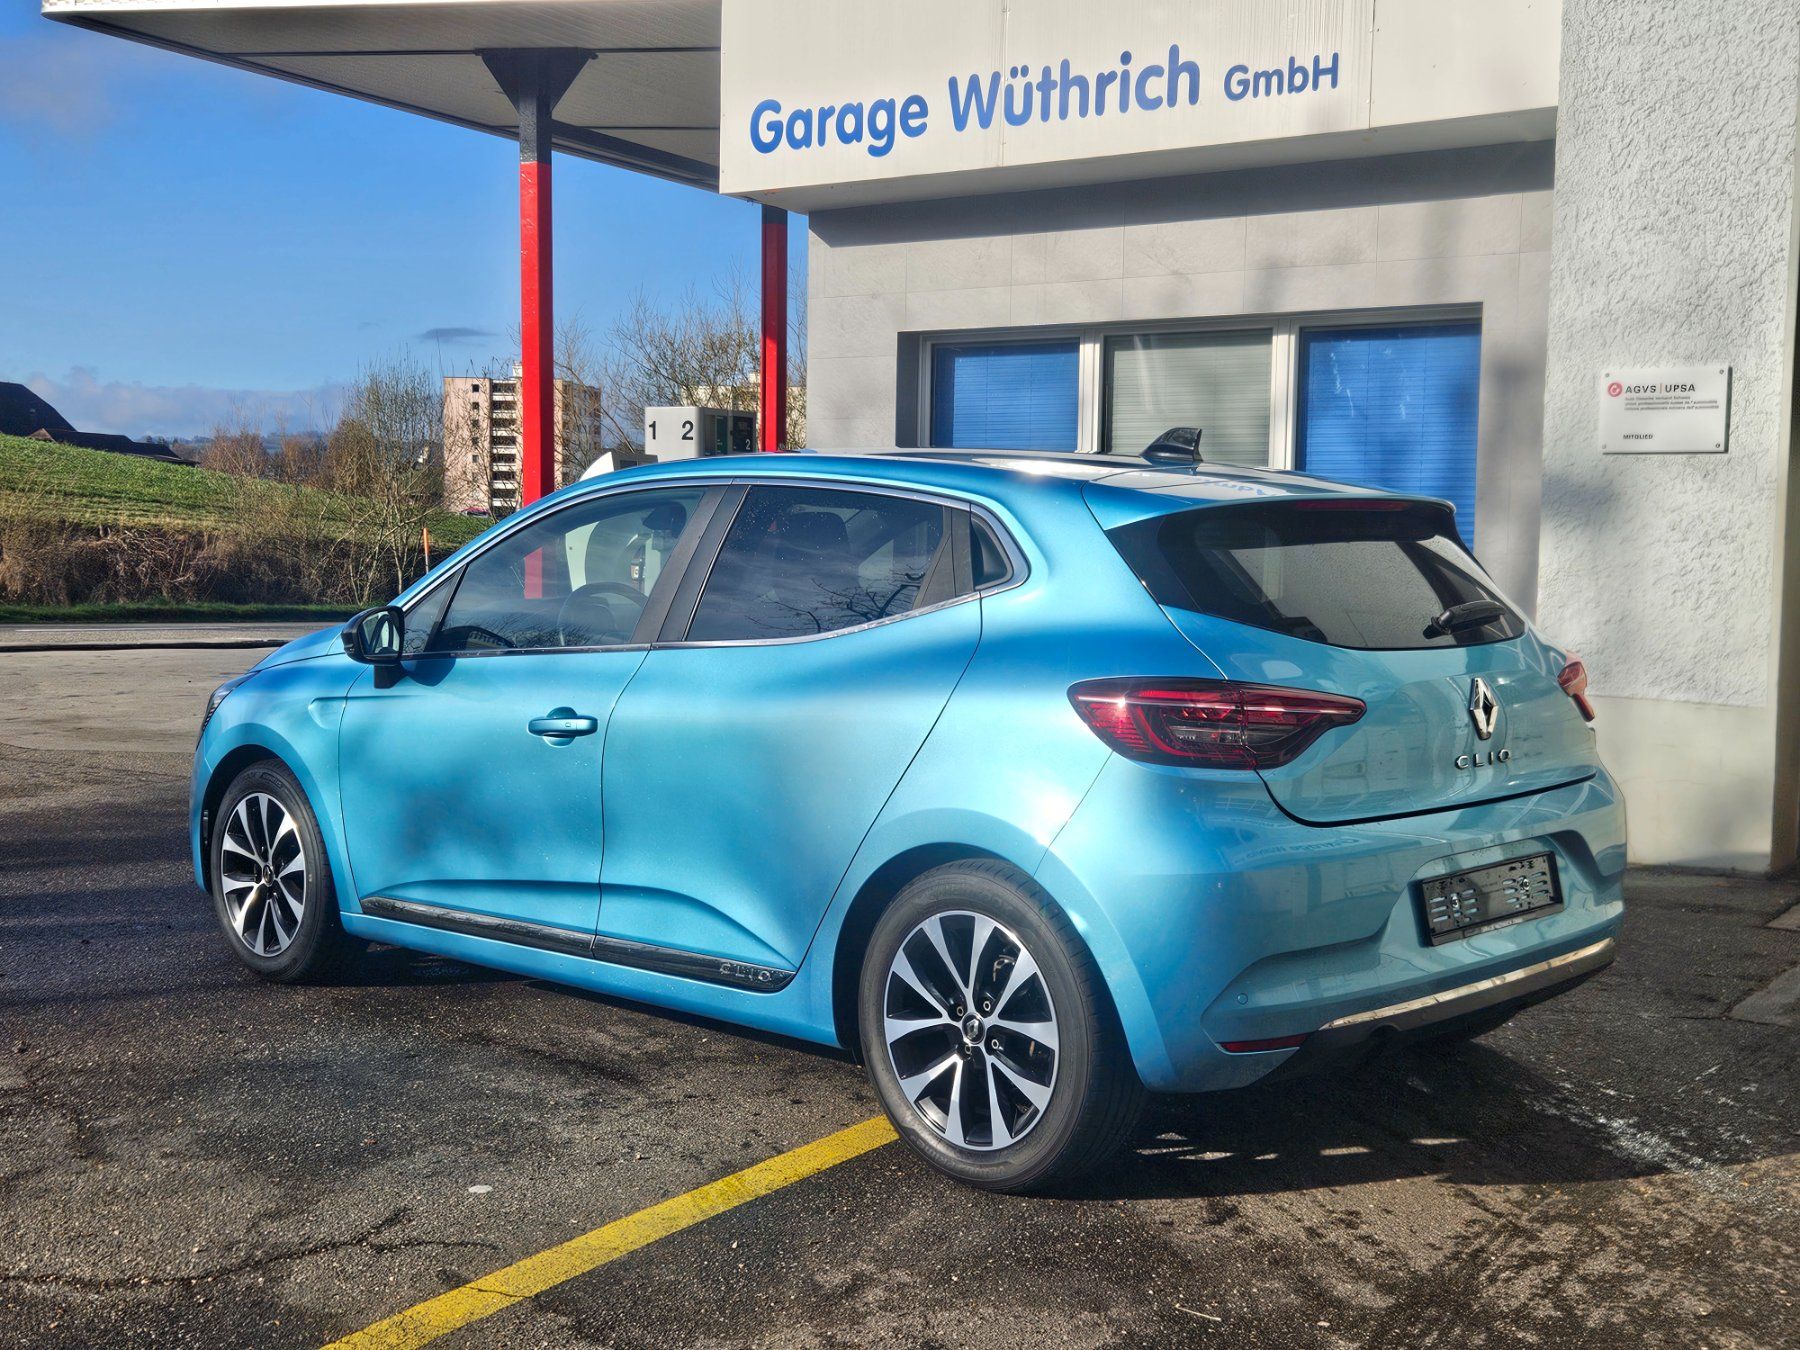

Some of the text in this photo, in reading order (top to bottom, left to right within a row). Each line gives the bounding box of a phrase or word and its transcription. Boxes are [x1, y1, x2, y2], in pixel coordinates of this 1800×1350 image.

[749, 44, 1340, 158] Garage Wüthrich GmbH
[1625, 383, 1696, 394] AGVS UPSA
[648, 420, 694, 441] 1 2
[745, 438, 751, 450] 2
[1455, 748, 1511, 770] CLIO
[720, 962, 771, 982] CLIO
